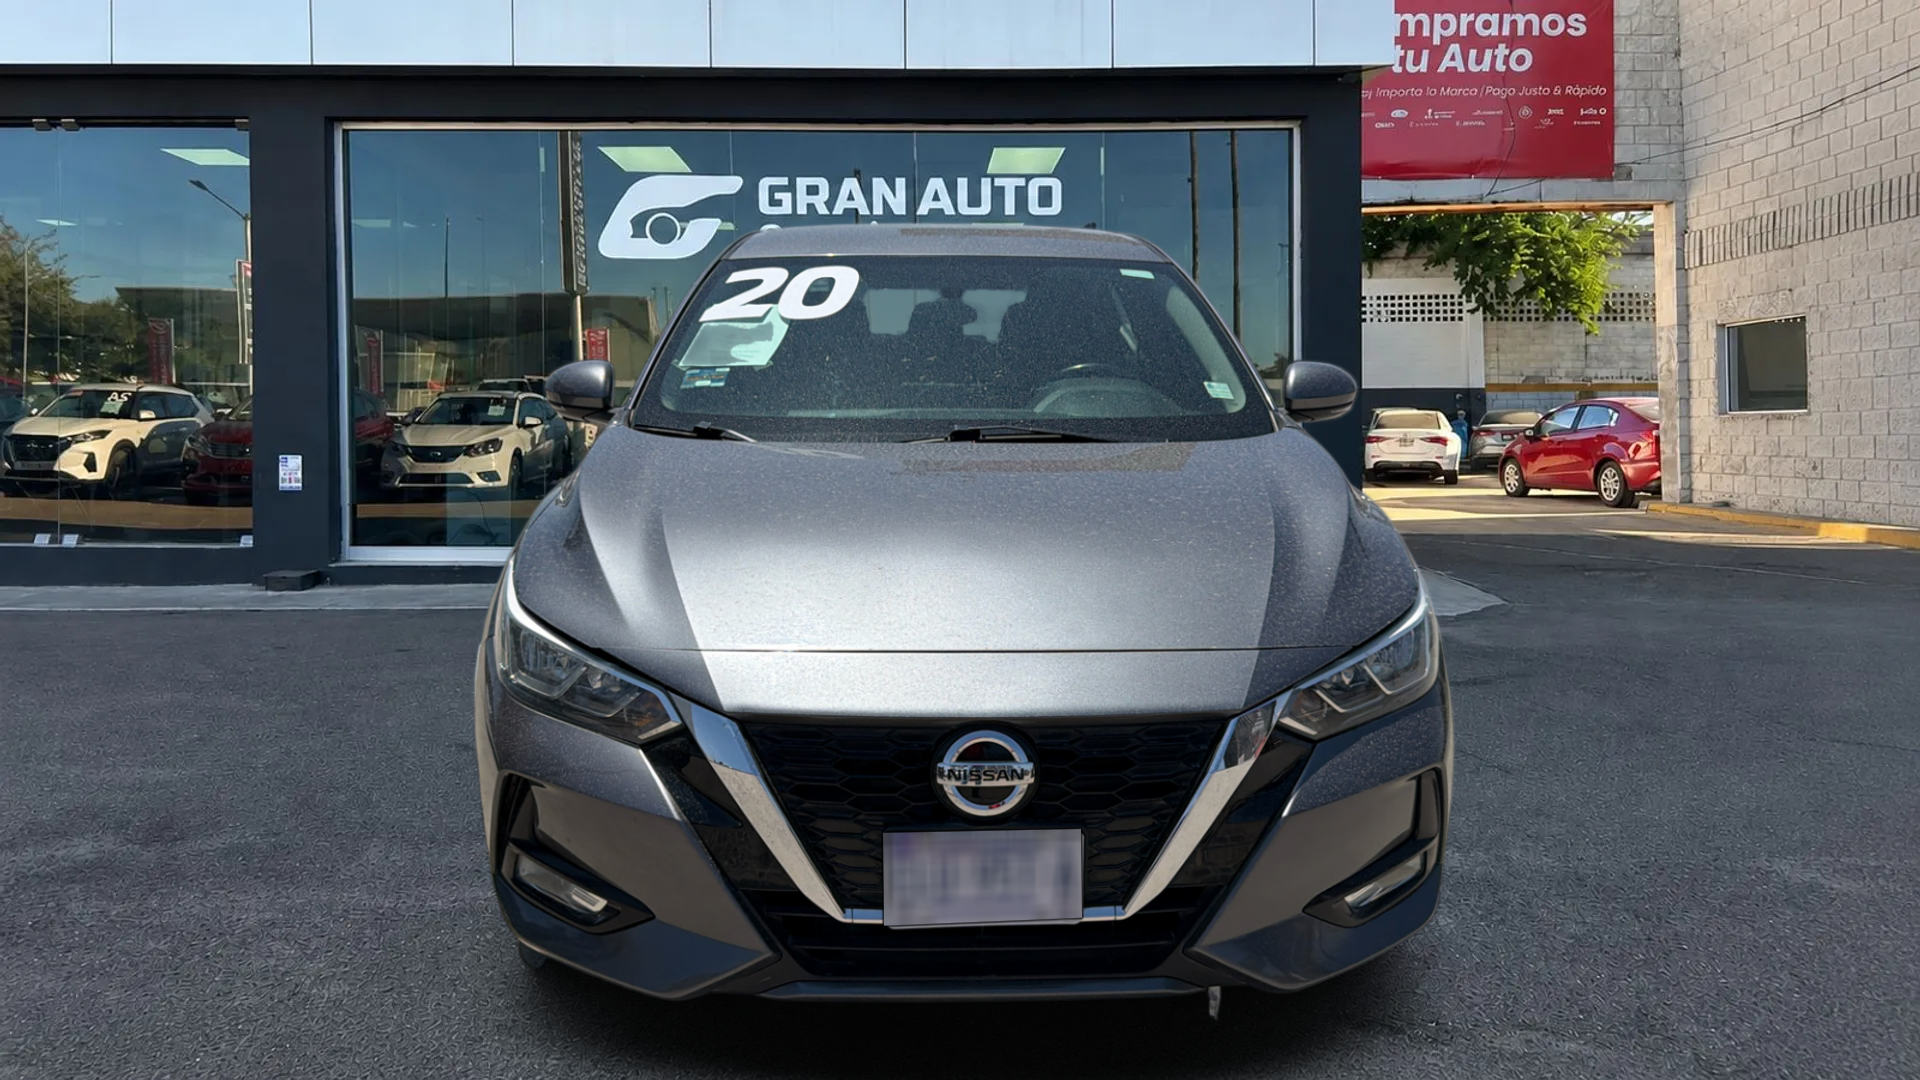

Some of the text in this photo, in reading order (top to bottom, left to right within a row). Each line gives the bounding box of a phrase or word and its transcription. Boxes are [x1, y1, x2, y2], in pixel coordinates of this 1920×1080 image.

[1395, 13, 1587, 45] mpramos
[1393, 43, 1533, 73] tu Auto
[1376, 87, 1423, 99] Importa
[1426, 86, 1437, 97] la
[1440, 86, 1478, 97] Marca
[1519, 86, 1551, 96] Justo
[1553, 85, 1562, 96] &
[758, 177, 1063, 216] GRAN AUTO
[699, 265, 860, 323] 20
[947, 768, 1025, 782] NISSAN
